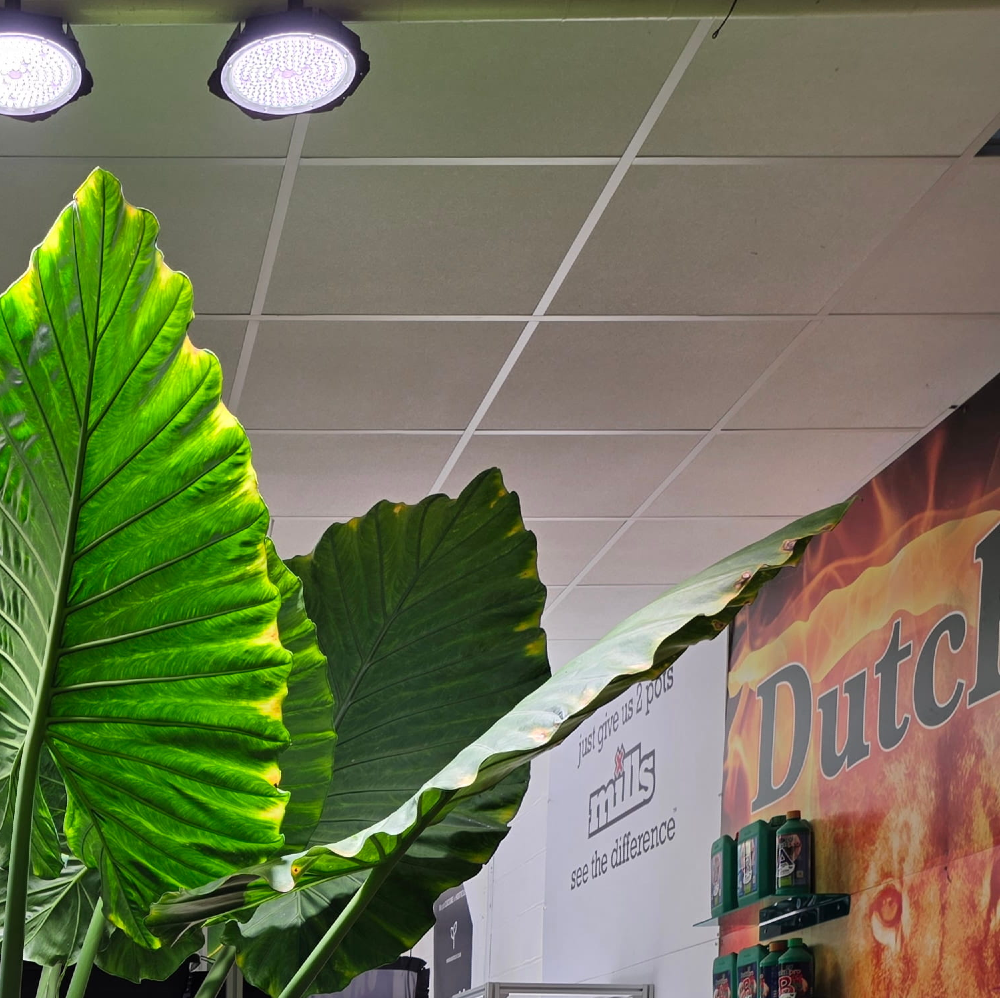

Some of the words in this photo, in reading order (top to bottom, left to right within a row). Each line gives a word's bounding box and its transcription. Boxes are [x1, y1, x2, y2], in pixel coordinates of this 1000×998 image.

[577, 725, 596, 769] just
[597, 711, 619, 754] give
[621, 697, 634, 725] us
[636, 682, 643, 714] 2
[645, 666, 674, 716] pots
[588, 742, 656, 839] mills
[570, 863, 588, 891] see
[591, 850, 608, 880] the
[611, 816, 676, 869] difference
